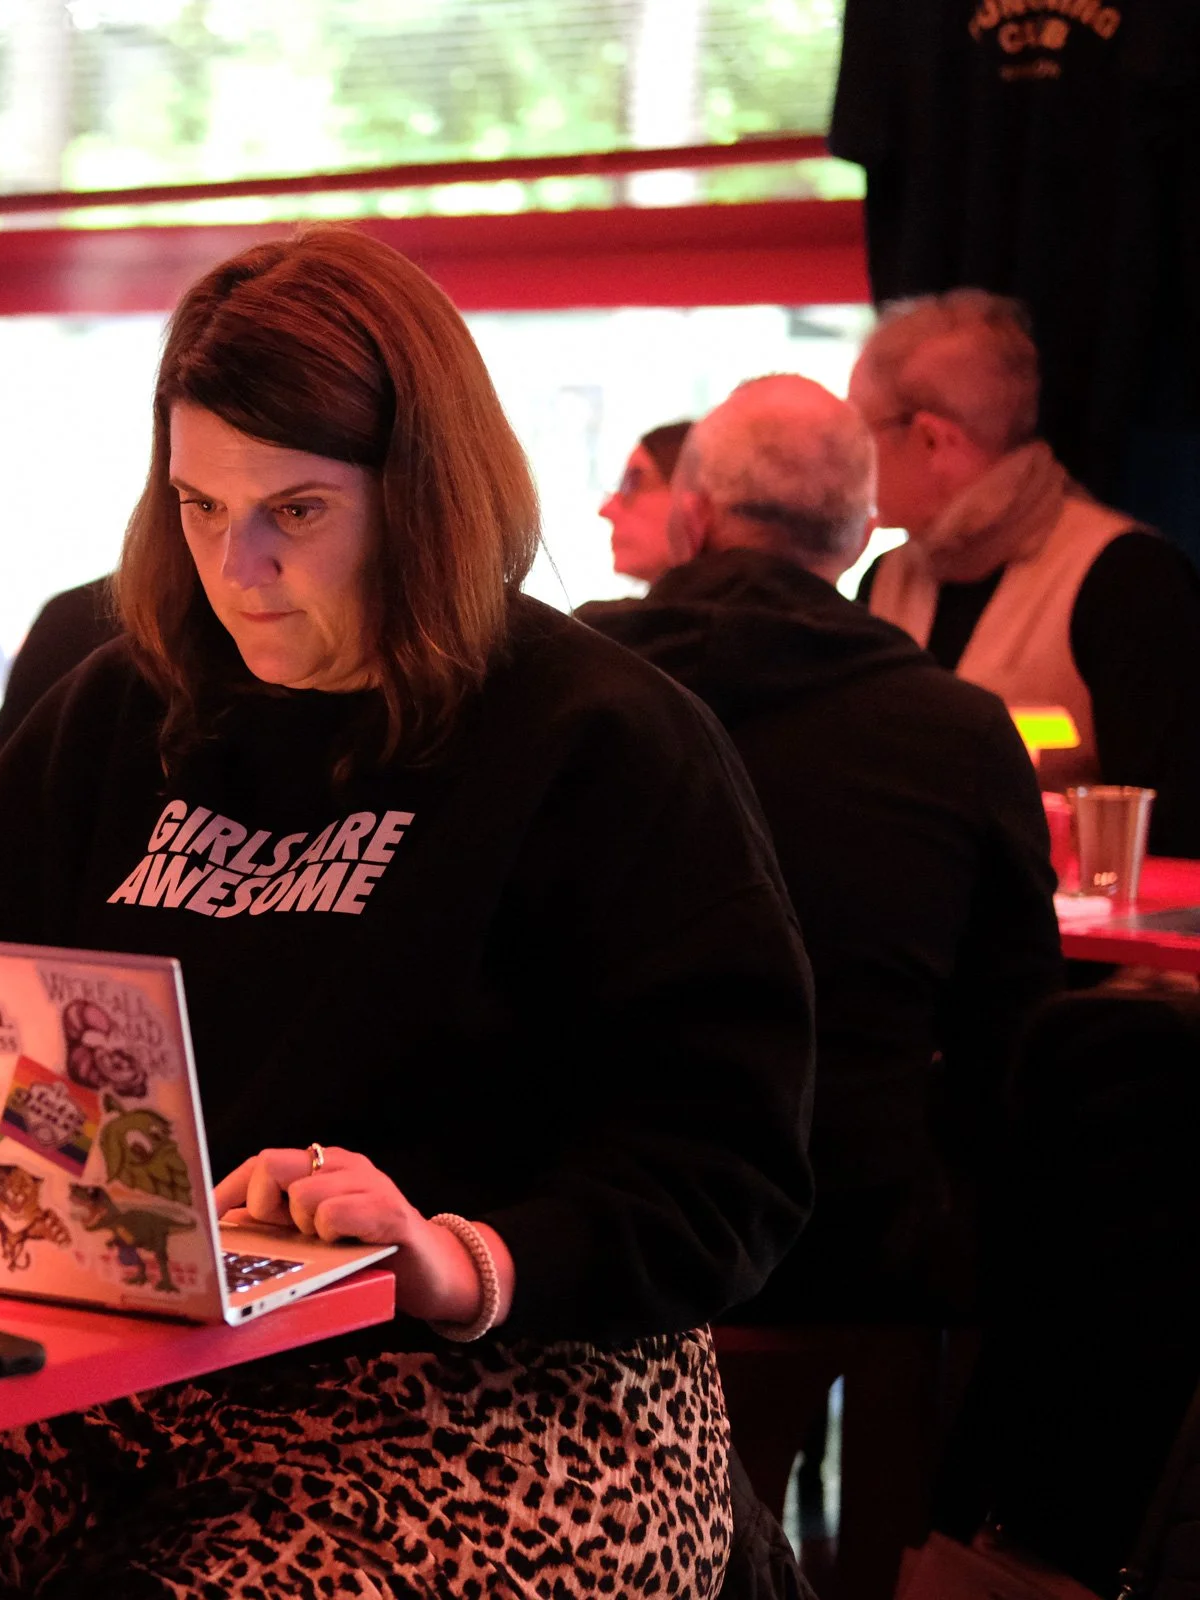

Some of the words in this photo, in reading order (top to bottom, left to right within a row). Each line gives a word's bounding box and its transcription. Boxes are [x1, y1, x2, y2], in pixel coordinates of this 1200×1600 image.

[148, 799, 309, 876] GIRLS
[289, 810, 416, 872] ARE
[106, 853, 387, 919] AWESOME
